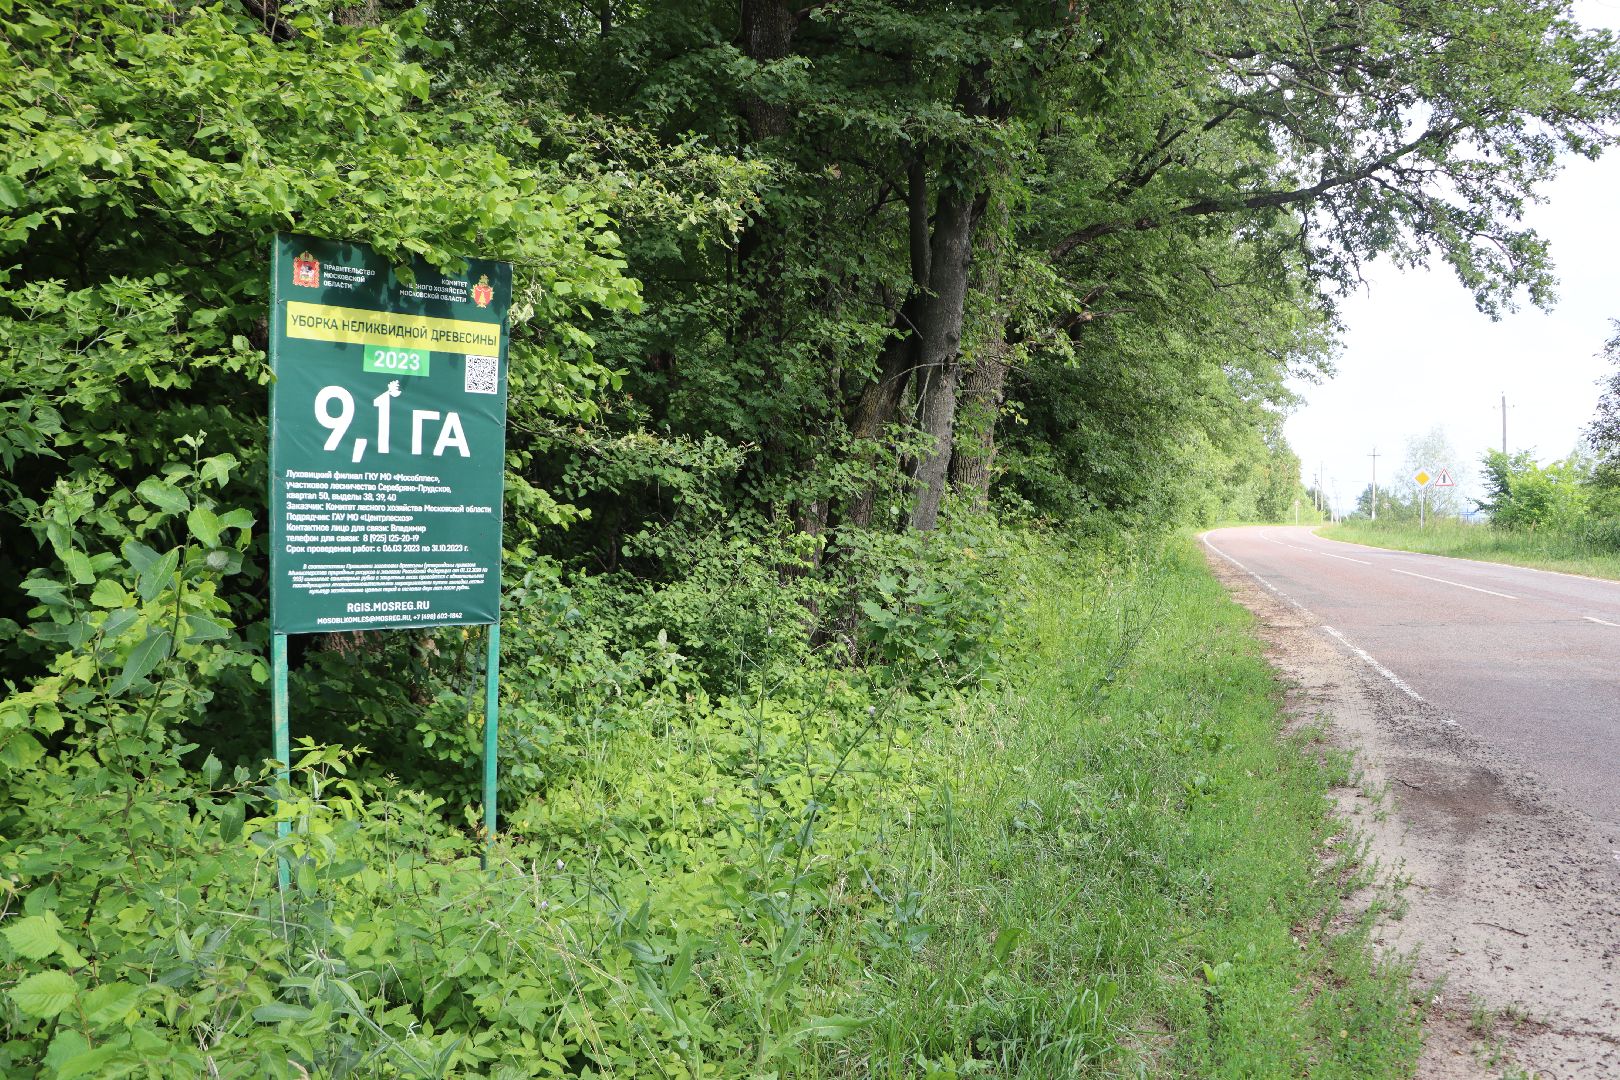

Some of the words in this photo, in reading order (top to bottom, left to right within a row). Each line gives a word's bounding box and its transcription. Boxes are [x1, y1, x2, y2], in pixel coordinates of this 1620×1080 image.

[323, 263, 376, 276] ПРАВИТЕЛЬСТВО
[323, 272, 366, 283] МОСКОВСКОЙ
[323, 281, 353, 289] ОБЛАСТИ
[441, 279, 468, 288] КОМИТЕТ
[433, 285, 468, 296] ХОЗЯЙСТВА
[440, 295, 467, 303] ОБЛАСТИ
[291, 314, 339, 330] УБОРКА
[342, 319, 428, 339] НЕЛИКВИДНОЙ
[430, 329, 497, 346] ДРЕВЕСИНЫ
[373, 350, 421, 371] 2023
[314, 381, 398, 463] 9,1
[411, 409, 471, 458] ГА
[286, 469, 333, 480] Луховицкий
[333, 471, 364, 481] филиал
[364, 472, 379, 481] ГКУ
[379, 472, 392, 481] МО
[286, 481, 329, 490] участковое
[330, 482, 377, 491] лесничество
[377, 483, 452, 493] Серебряно-Прудское,
[286, 492, 317, 501] квартал
[318, 491, 330, 501] 50,
[331, 493, 362, 502] выделы
[363, 493, 375, 502] 38,
[375, 493, 386, 502] 39,
[286, 501, 325, 511] Заказчик:
[325, 502, 356, 511] Комитет
[357, 504, 386, 512] лесного
[387, 503, 423, 512] хозяйства
[424, 504, 464, 513] Московской
[465, 505, 492, 513] области
[286, 512, 331, 522] Подрядчик:
[331, 513, 346, 521] ГАУ
[346, 513, 359, 522] МО
[360, 513, 414, 523] «Центрлесхоз»
[286, 522, 330, 532] Контактное
[331, 524, 350, 533] лицо
[350, 524, 365, 533] для
[390, 523, 427, 533] Владимир
[286, 533, 319, 543] телефон
[320, 534, 335, 543] для
[336, 534, 360, 542] связи:
[362, 533, 369, 542] 8
[369, 533, 387, 544] (925)
[388, 534, 420, 542] 125-20-19
[286, 544, 306, 554] Срок
[306, 545, 352, 554] проведения
[352, 544, 376, 554] работ:
[403, 544, 421, 552] 2023
[431, 544, 464, 552] 31.10.2023
[347, 600, 430, 613] RGIS.MOSREG.RU
[317, 614, 412, 625] MOSOBLKOMLES@MOSREG.RU,
